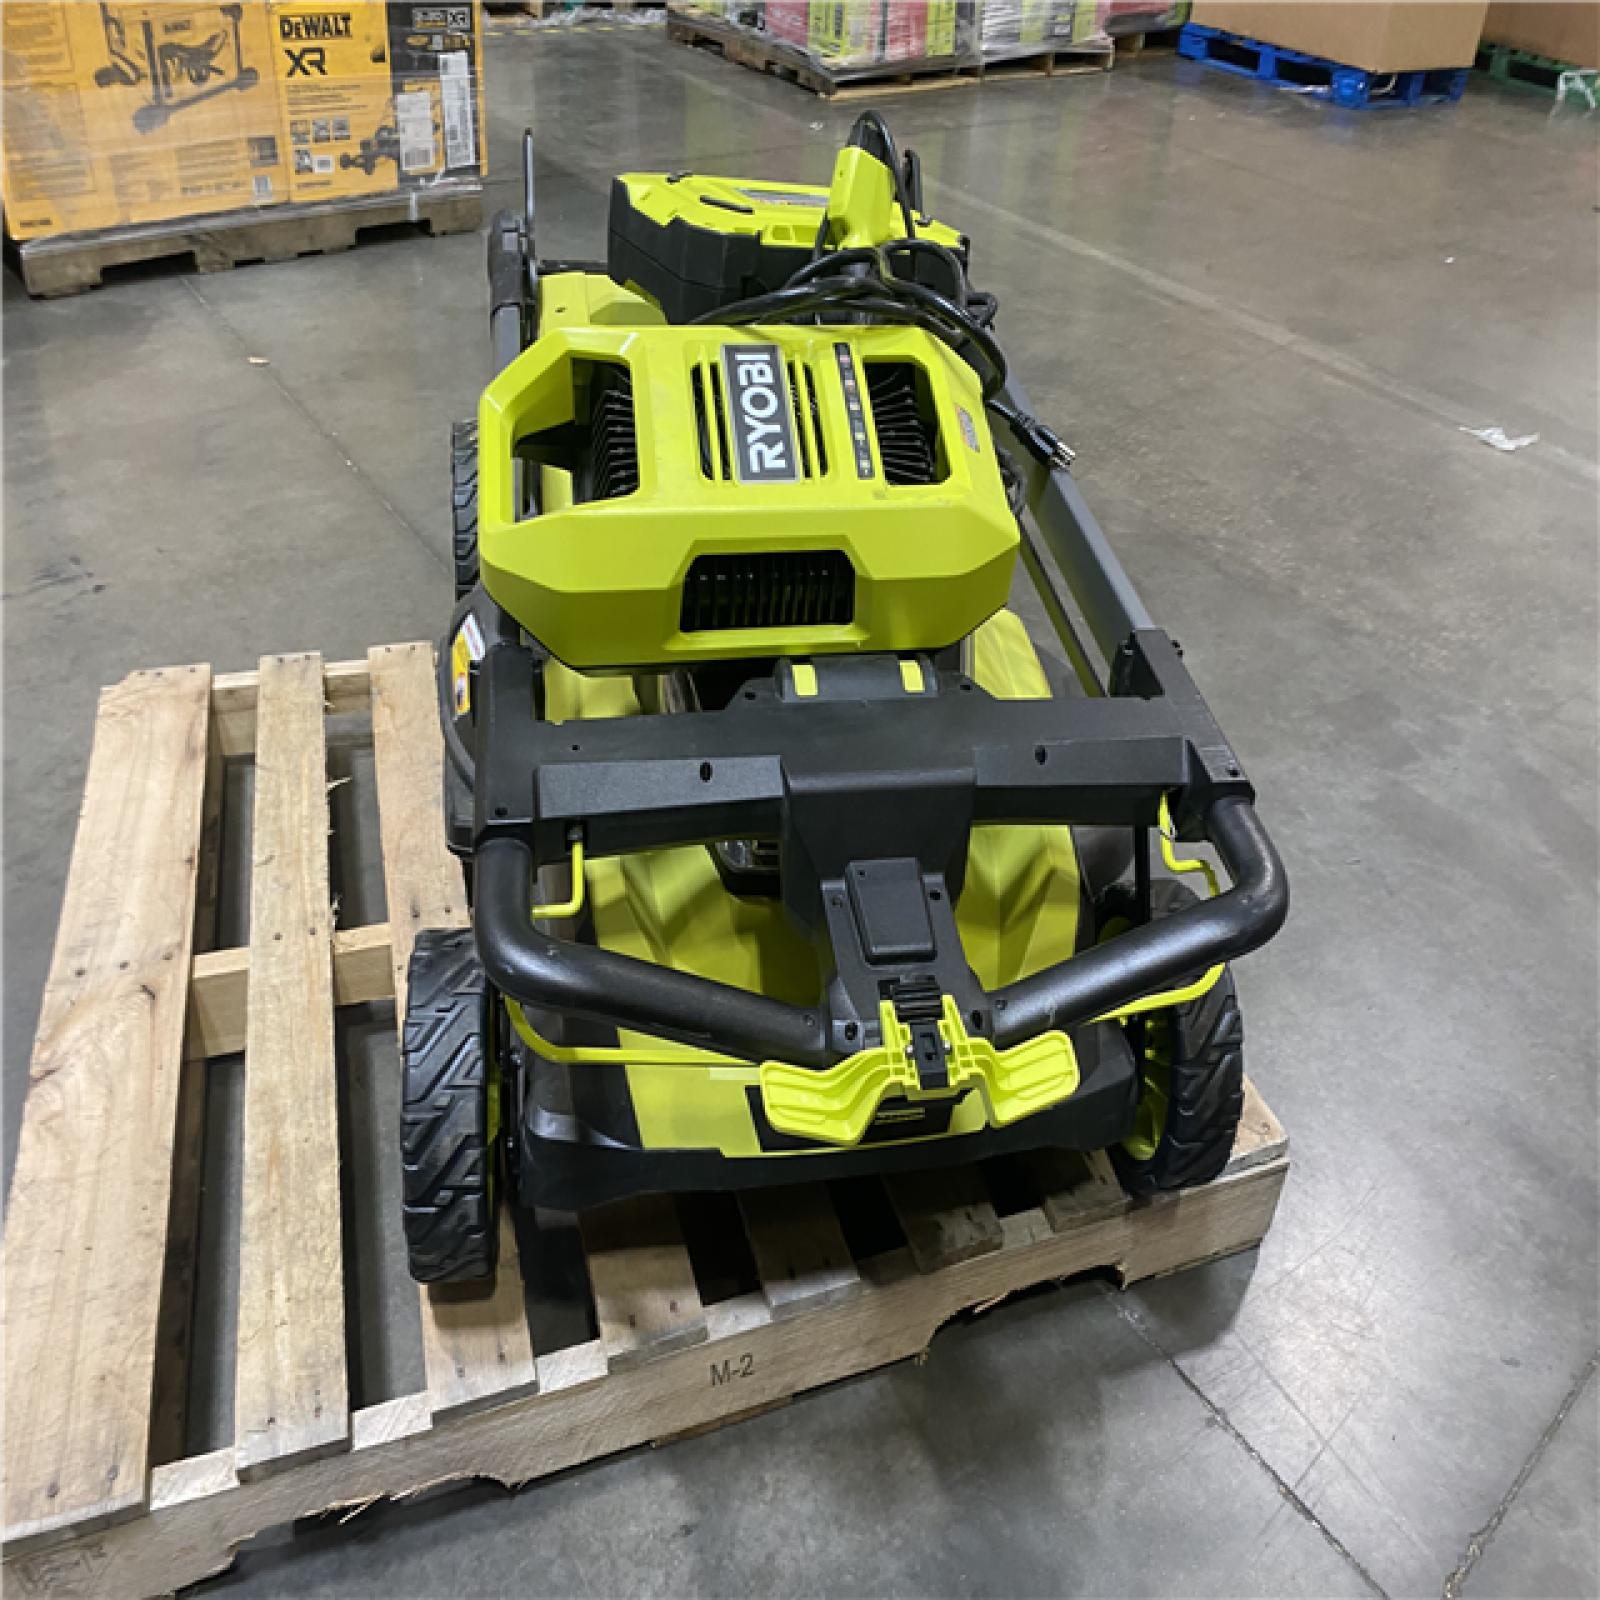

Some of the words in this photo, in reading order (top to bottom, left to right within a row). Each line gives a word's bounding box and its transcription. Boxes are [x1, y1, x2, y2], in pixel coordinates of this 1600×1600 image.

[284, 48, 327, 77] XR
[735, 352, 786, 473] RYOBI
[710, 1353, 755, 1386] M-2
